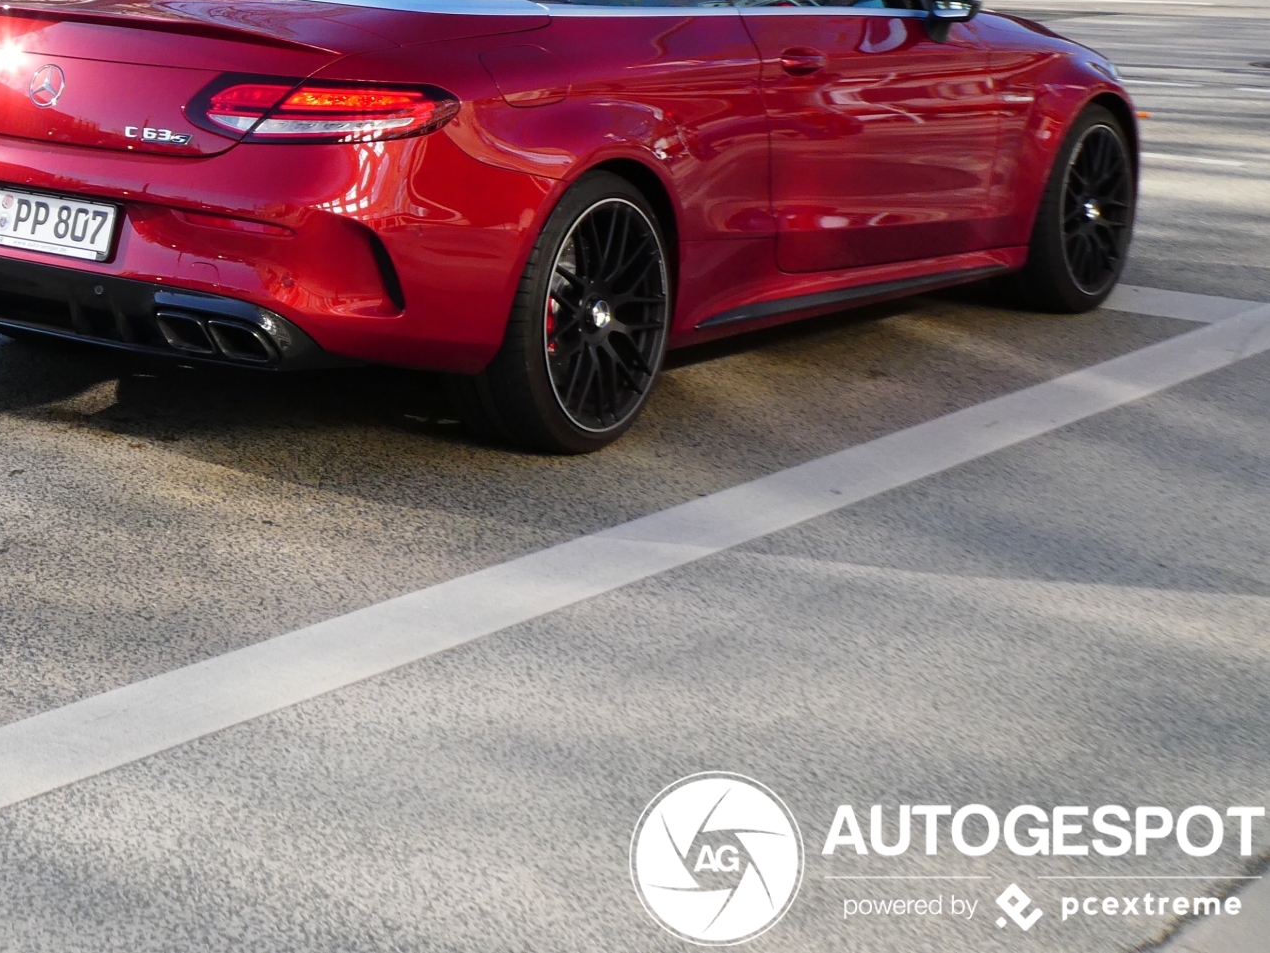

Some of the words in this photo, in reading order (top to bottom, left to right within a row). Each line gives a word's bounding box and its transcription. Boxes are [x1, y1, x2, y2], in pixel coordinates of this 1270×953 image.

[124, 126, 138, 138] C
[13, 198, 50, 235] PP
[53, 205, 109, 245] 807
[13, 239, 67, 253] www.auto-senger.de
